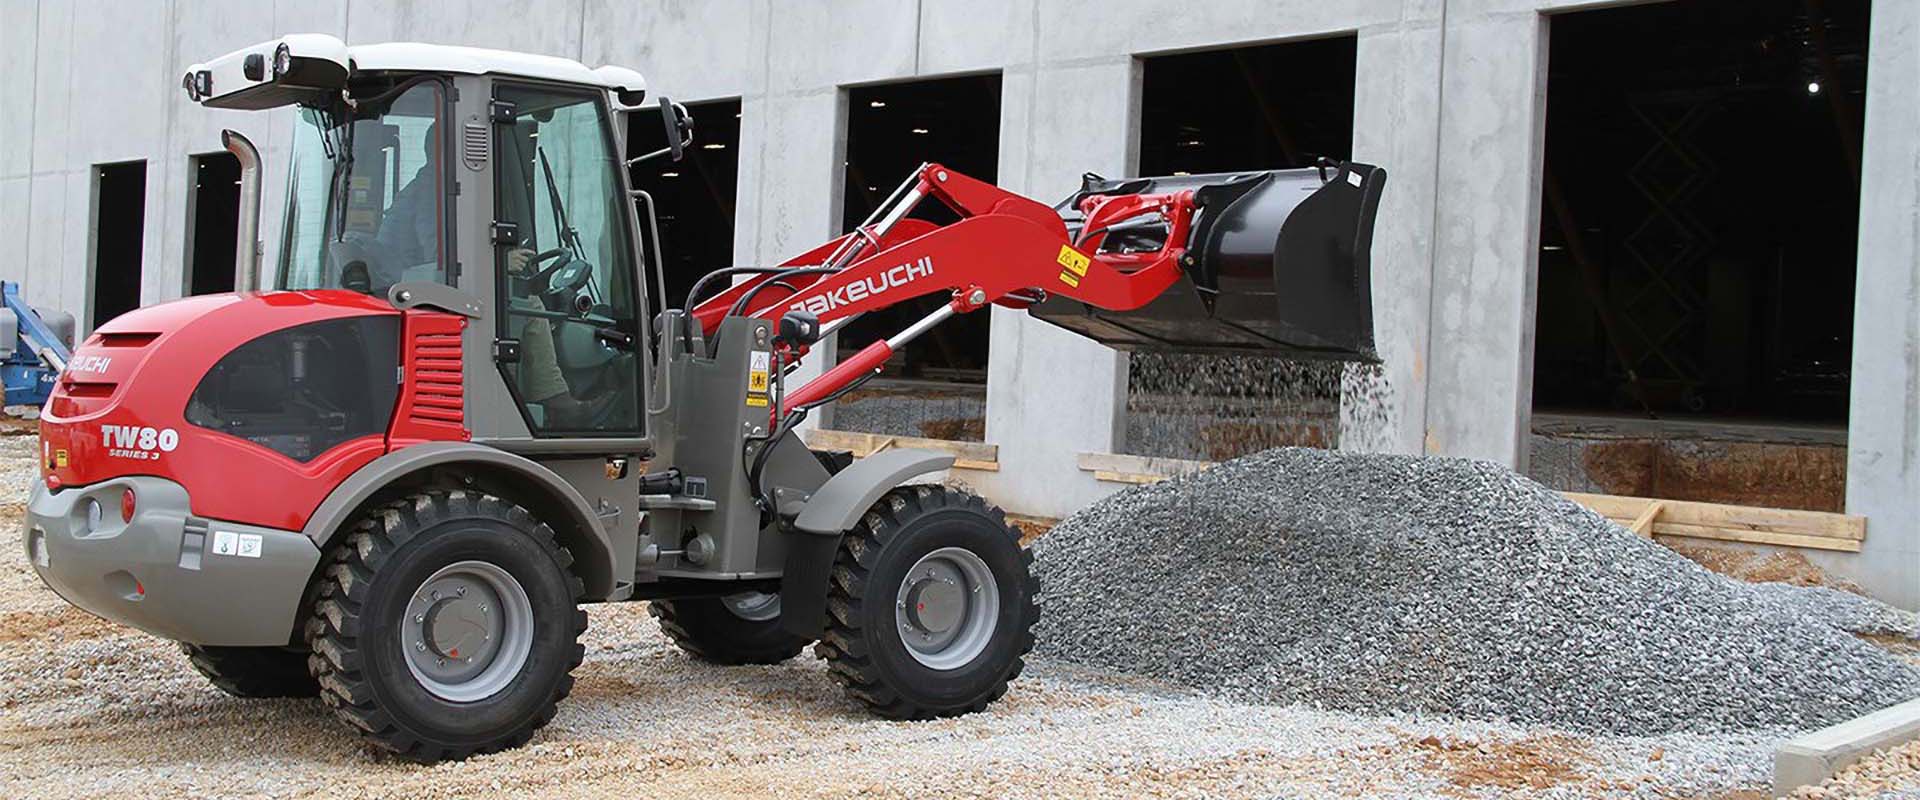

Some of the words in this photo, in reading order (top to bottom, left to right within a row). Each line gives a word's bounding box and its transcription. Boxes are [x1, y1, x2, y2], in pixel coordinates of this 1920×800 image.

[40, 373, 58, 382] 4x
[101, 425, 179, 452] TW80
[109, 448, 149, 460] SERIES
[150, 452, 160, 460] 3
